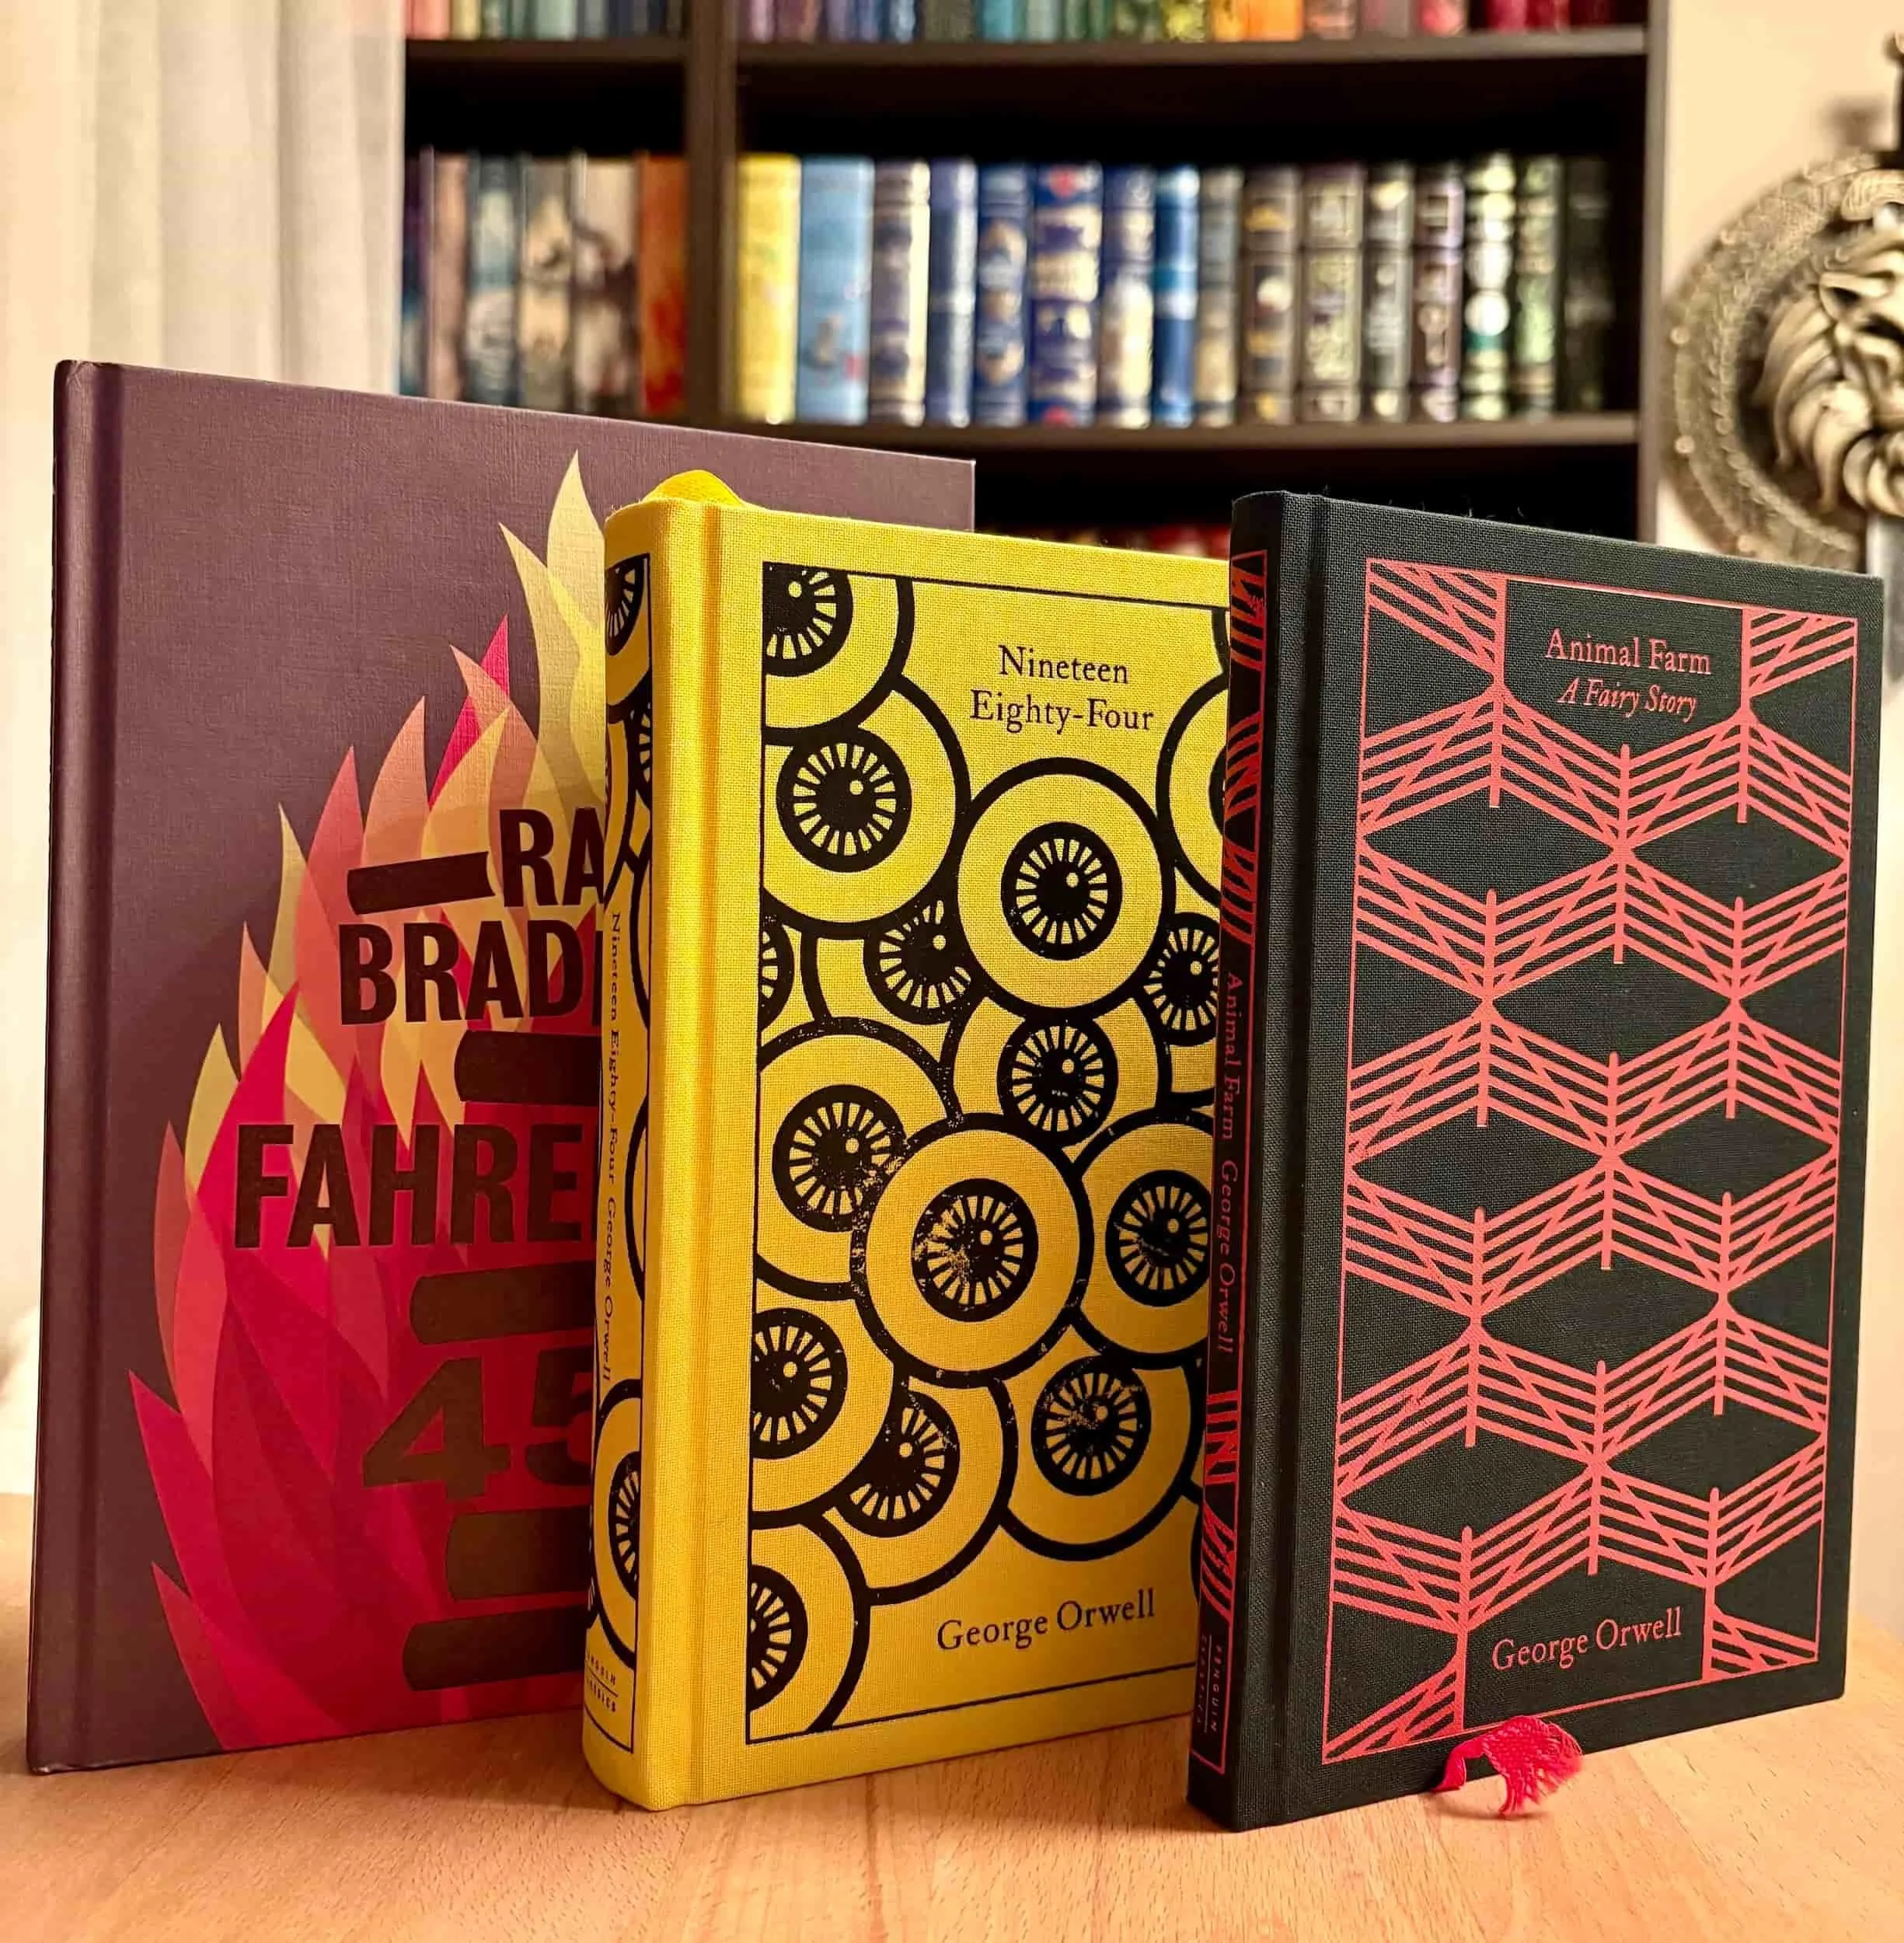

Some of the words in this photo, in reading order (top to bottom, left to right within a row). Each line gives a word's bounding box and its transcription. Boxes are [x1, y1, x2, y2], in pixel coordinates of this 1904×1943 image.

[998, 644, 1128, 684] Nineteen
[1544, 626, 1641, 668] Animal
[1648, 637, 1711, 675] Farm
[970, 689, 1155, 734] Eighty-Four
[1557, 677, 1580, 703] A
[1583, 678, 1641, 718] Fairy
[1644, 684, 1697, 723] Story
[339, 919, 603, 1025] BRAD
[611, 913, 621, 1021] Nineteen
[1224, 972, 1243, 1066] Animal
[609, 1030, 620, 1185] Eighty-Four
[1222, 1076, 1240, 1140] Farm
[235, 1124, 598, 1248] FAHRE
[1216, 1160, 1238, 1256] George
[603, 1197, 616, 1289] George
[602, 1296, 613, 1381] Orwell
[1216, 1262, 1236, 1354] Orwell
[936, 1619, 1048, 1650] George
[1056, 1587, 1155, 1631] Orwell
[1491, 1638, 1588, 1671] George
[1595, 1604, 1682, 1650] Orwell
